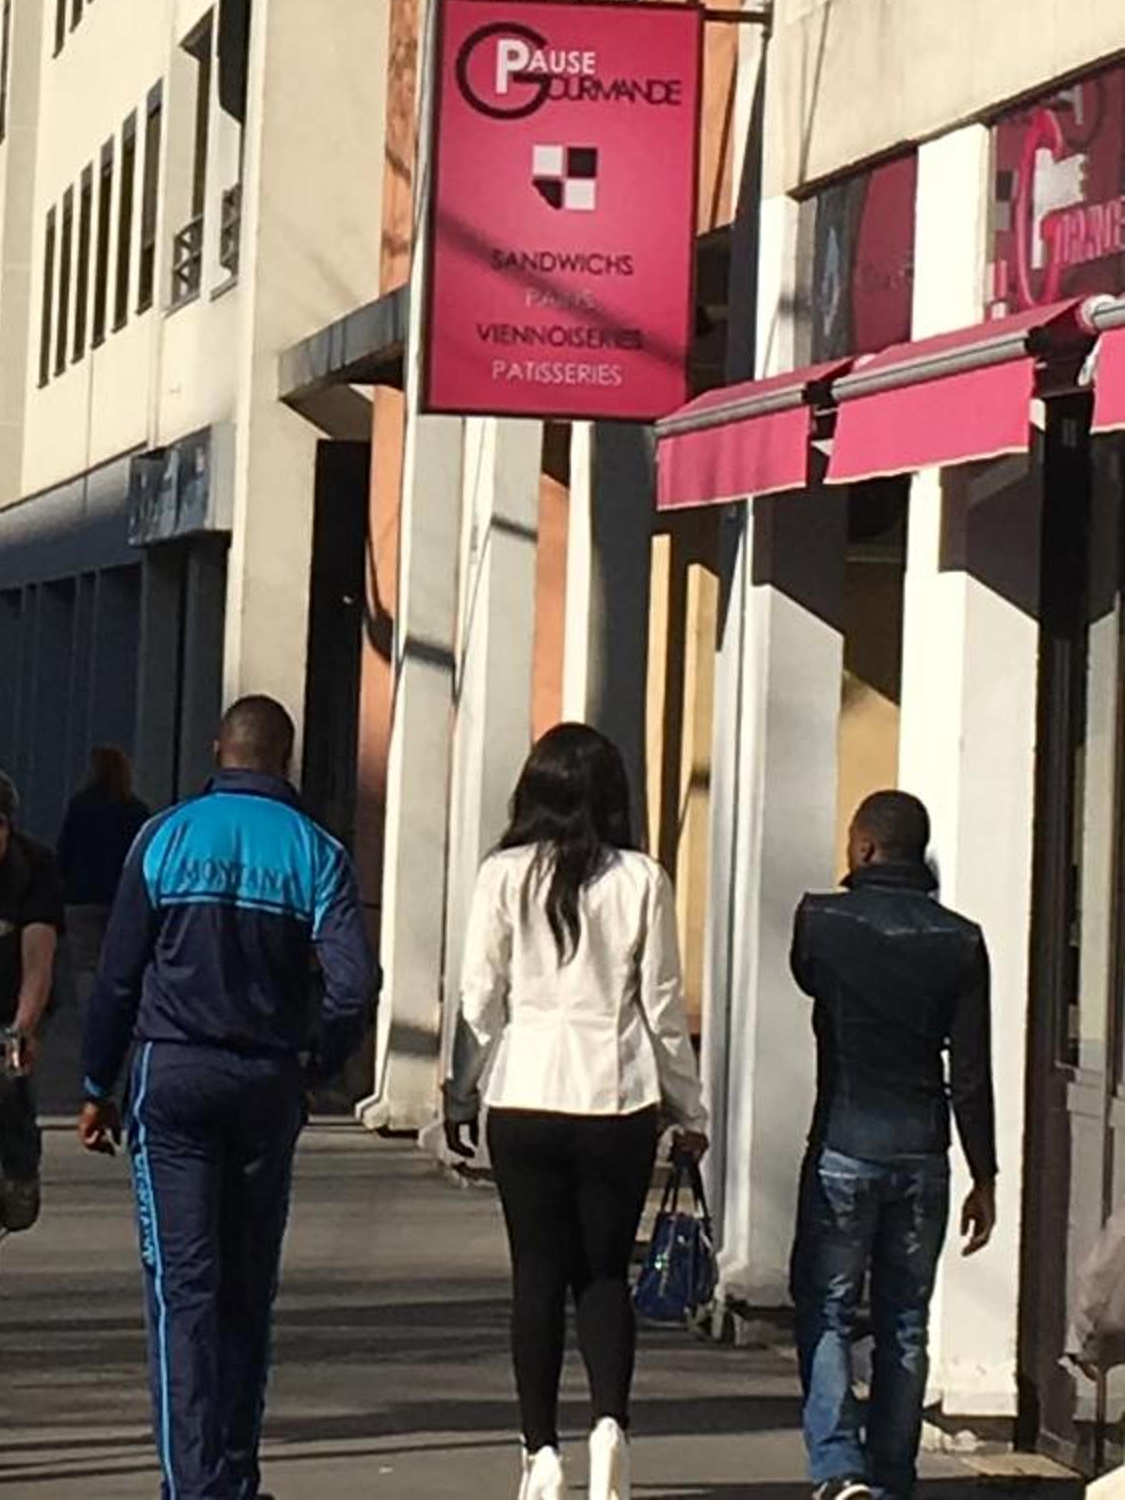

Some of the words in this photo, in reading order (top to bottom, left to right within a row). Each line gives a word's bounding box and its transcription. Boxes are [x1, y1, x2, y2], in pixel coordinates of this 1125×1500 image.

[454, 21, 682, 121] GOURMANDE
[495, 38, 596, 95] PAUSE
[491, 249, 634, 276] SANDWICHS
[477, 323, 643, 350] VIENNOISERIES
[492, 359, 623, 387] PATISSERIES
